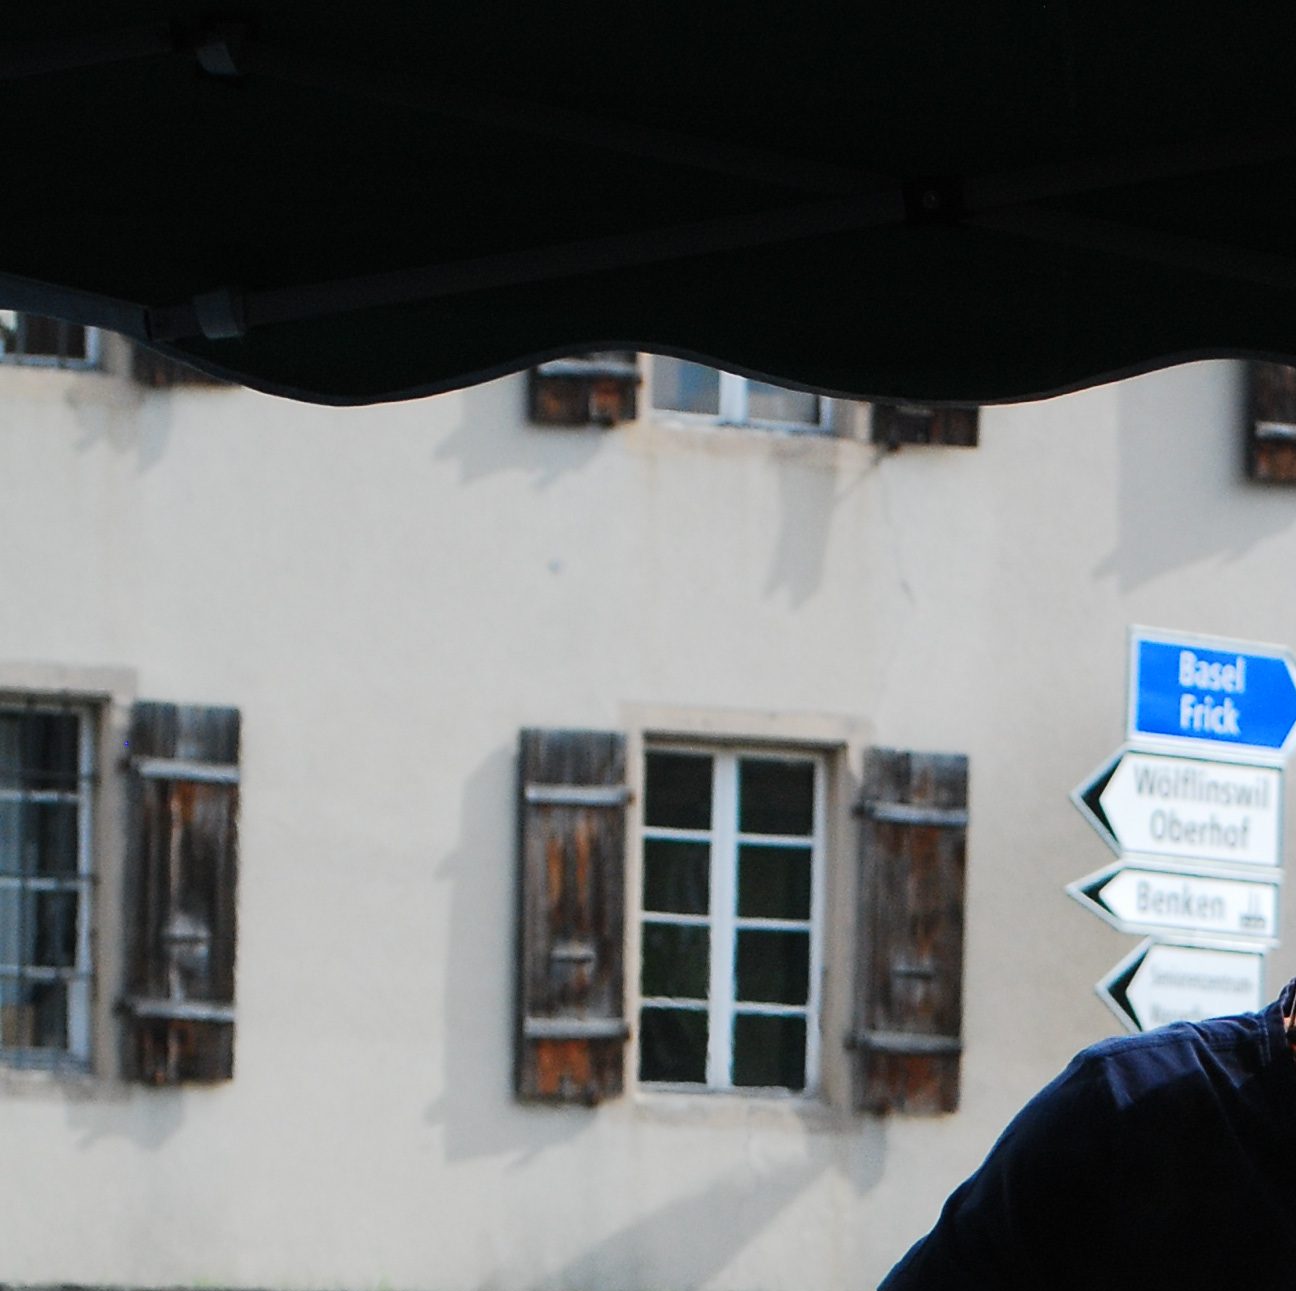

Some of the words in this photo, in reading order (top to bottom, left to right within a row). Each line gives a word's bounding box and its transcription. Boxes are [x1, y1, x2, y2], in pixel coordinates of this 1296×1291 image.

[1178, 651, 1246, 693] Basel
[1179, 694, 1241, 735] Frick
[1150, 810, 1249, 849] Oberhof
[1135, 880, 1226, 922] Benken
